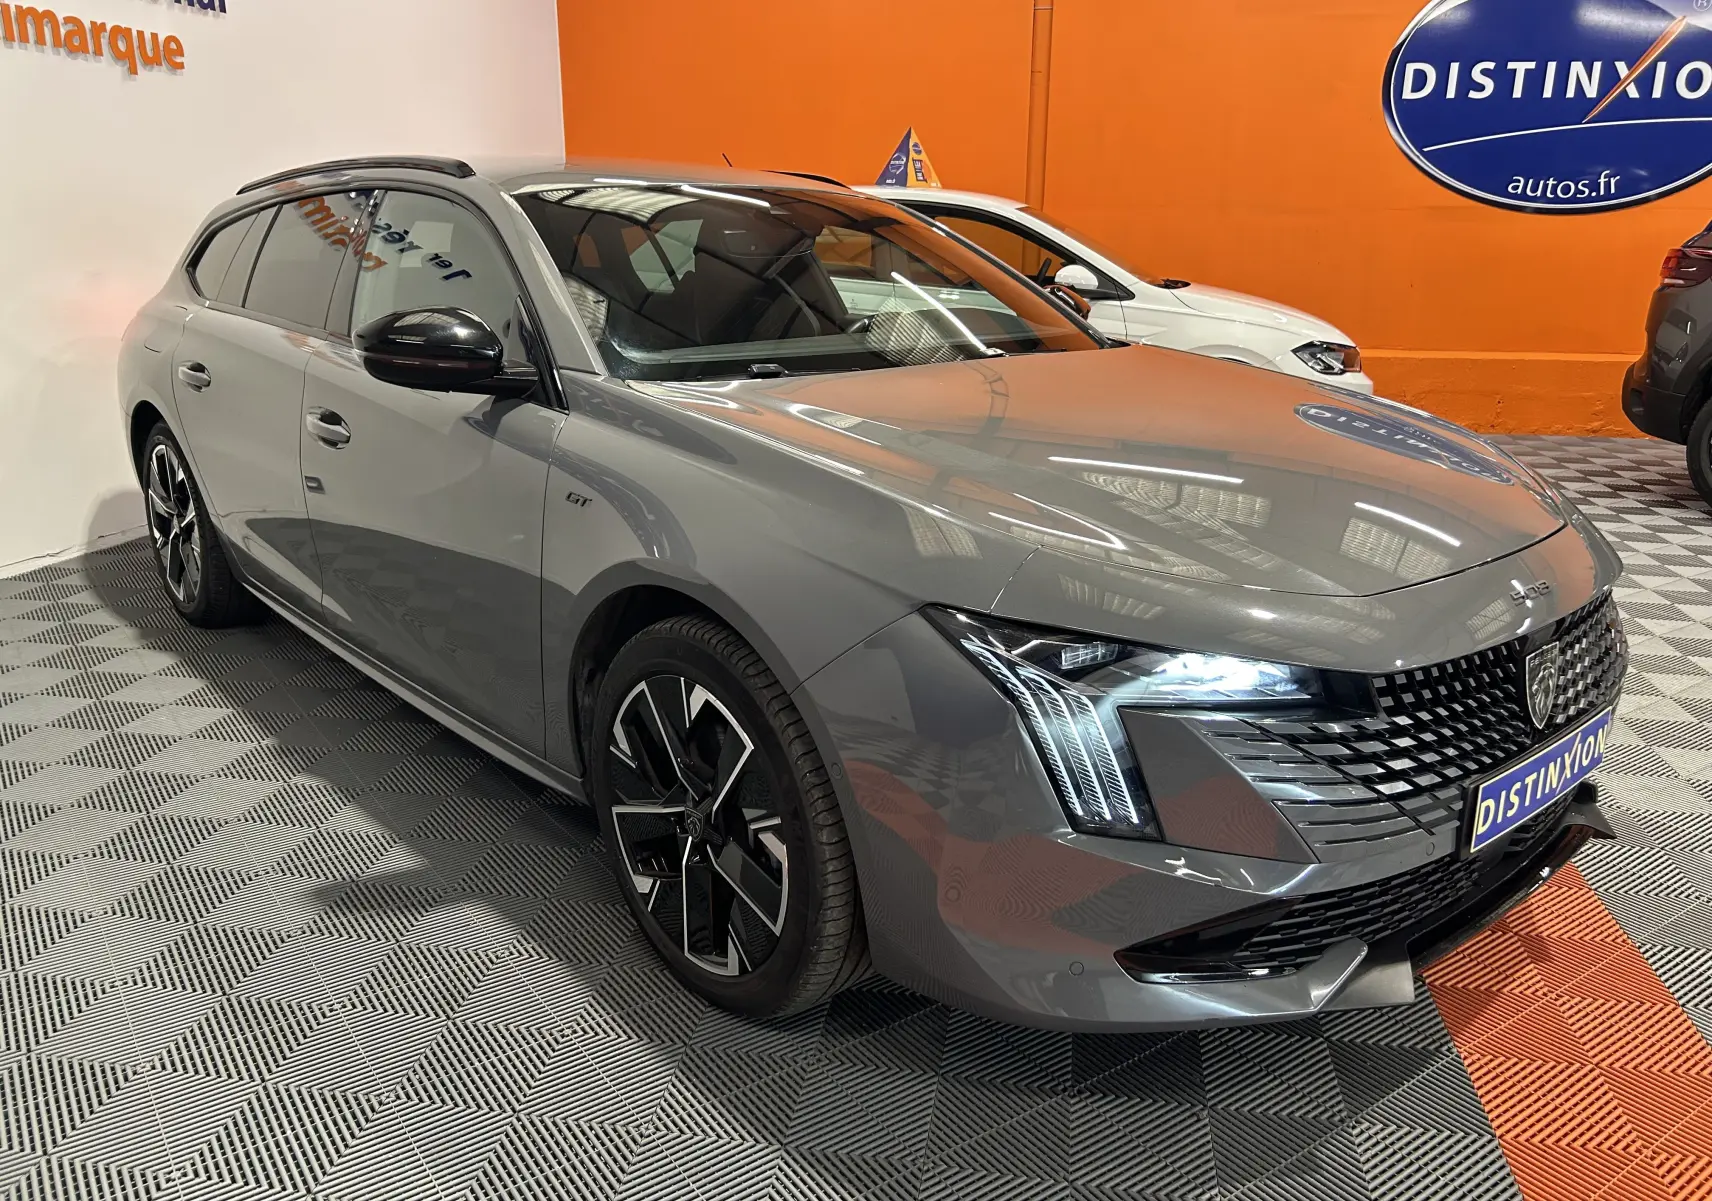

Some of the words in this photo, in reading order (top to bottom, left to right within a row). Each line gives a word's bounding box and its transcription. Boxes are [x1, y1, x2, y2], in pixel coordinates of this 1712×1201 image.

[1402, 60, 1712, 100] DISTINXIO
[1507, 170, 1621, 198] autos.fr
[565, 491, 593, 507] GT
[1509, 580, 1552, 606] 508
[1476, 724, 1609, 836] DISTINXION
